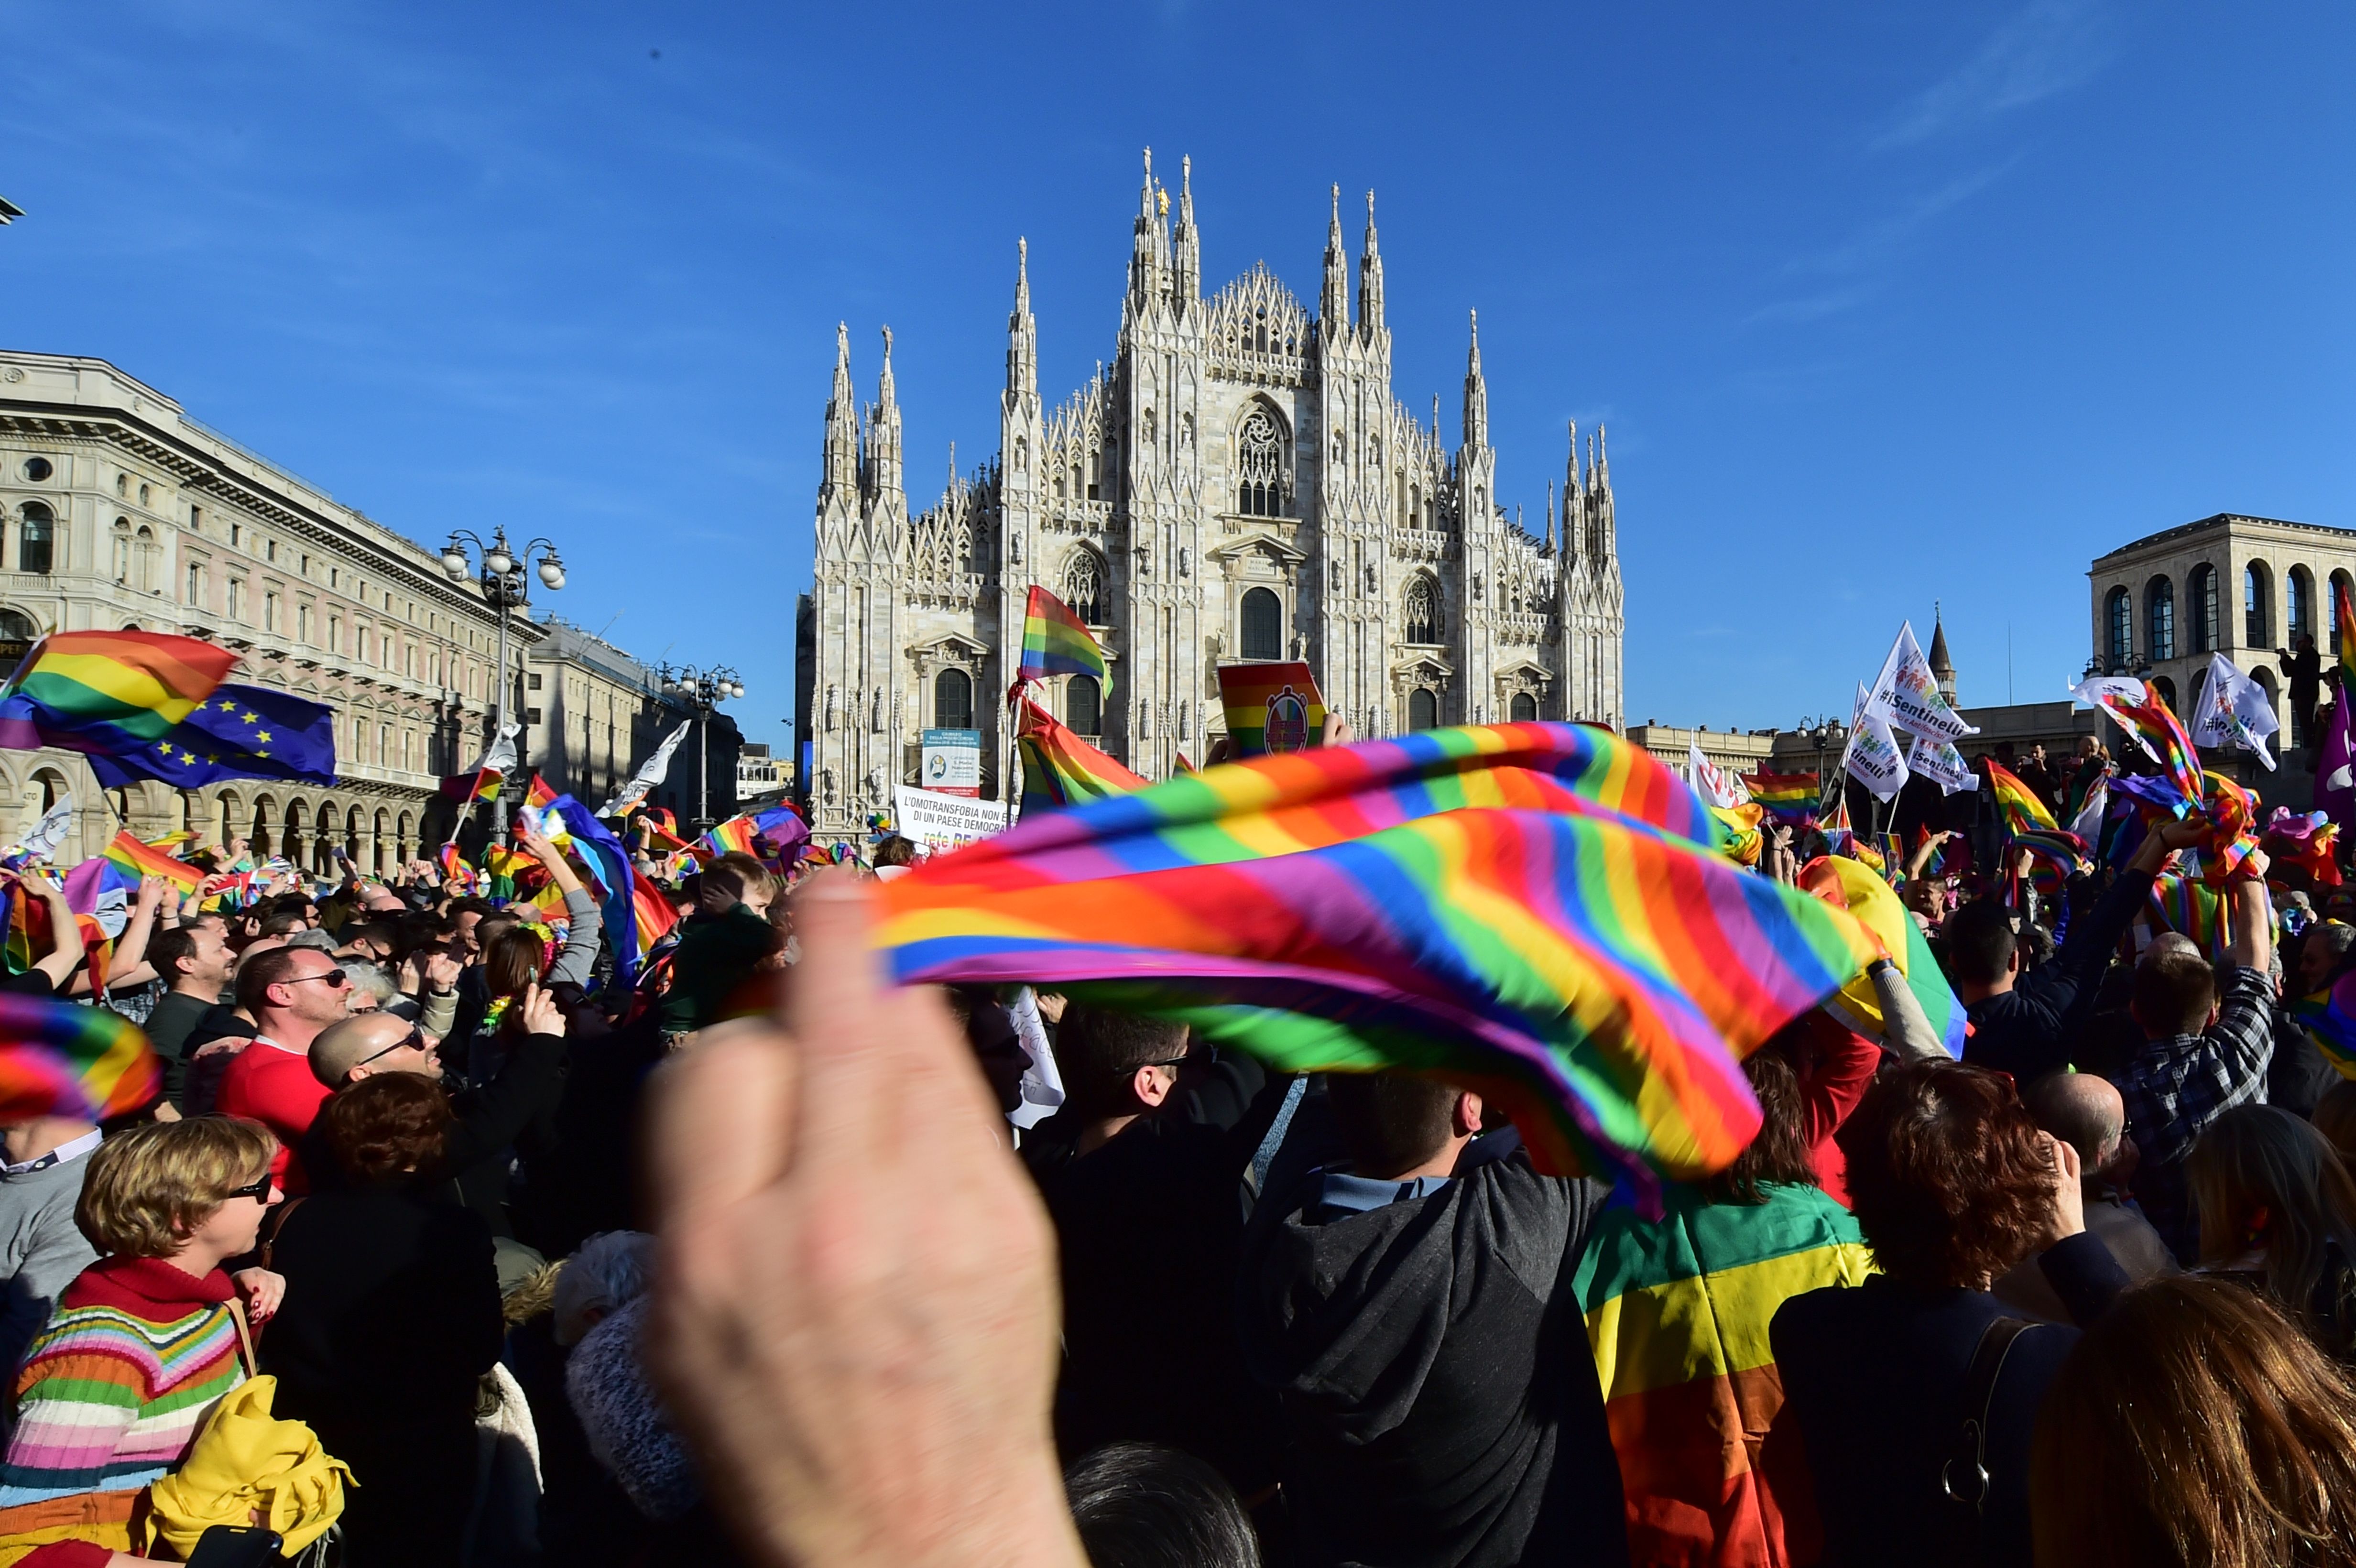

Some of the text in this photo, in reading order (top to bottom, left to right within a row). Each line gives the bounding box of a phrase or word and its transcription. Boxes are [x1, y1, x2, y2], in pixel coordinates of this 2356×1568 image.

[1879, 689, 1964, 736] #iSentinelli
[1851, 748, 1886, 779] tinelli
[904, 795, 979, 819] L'OMOTRANSFOBIA
[982, 809, 1000, 821] NON
[1010, 814, 1018, 824] DE
[914, 810, 1006, 835] DI UN PAESE DEMOCRA
[924, 831, 949, 848] rete
